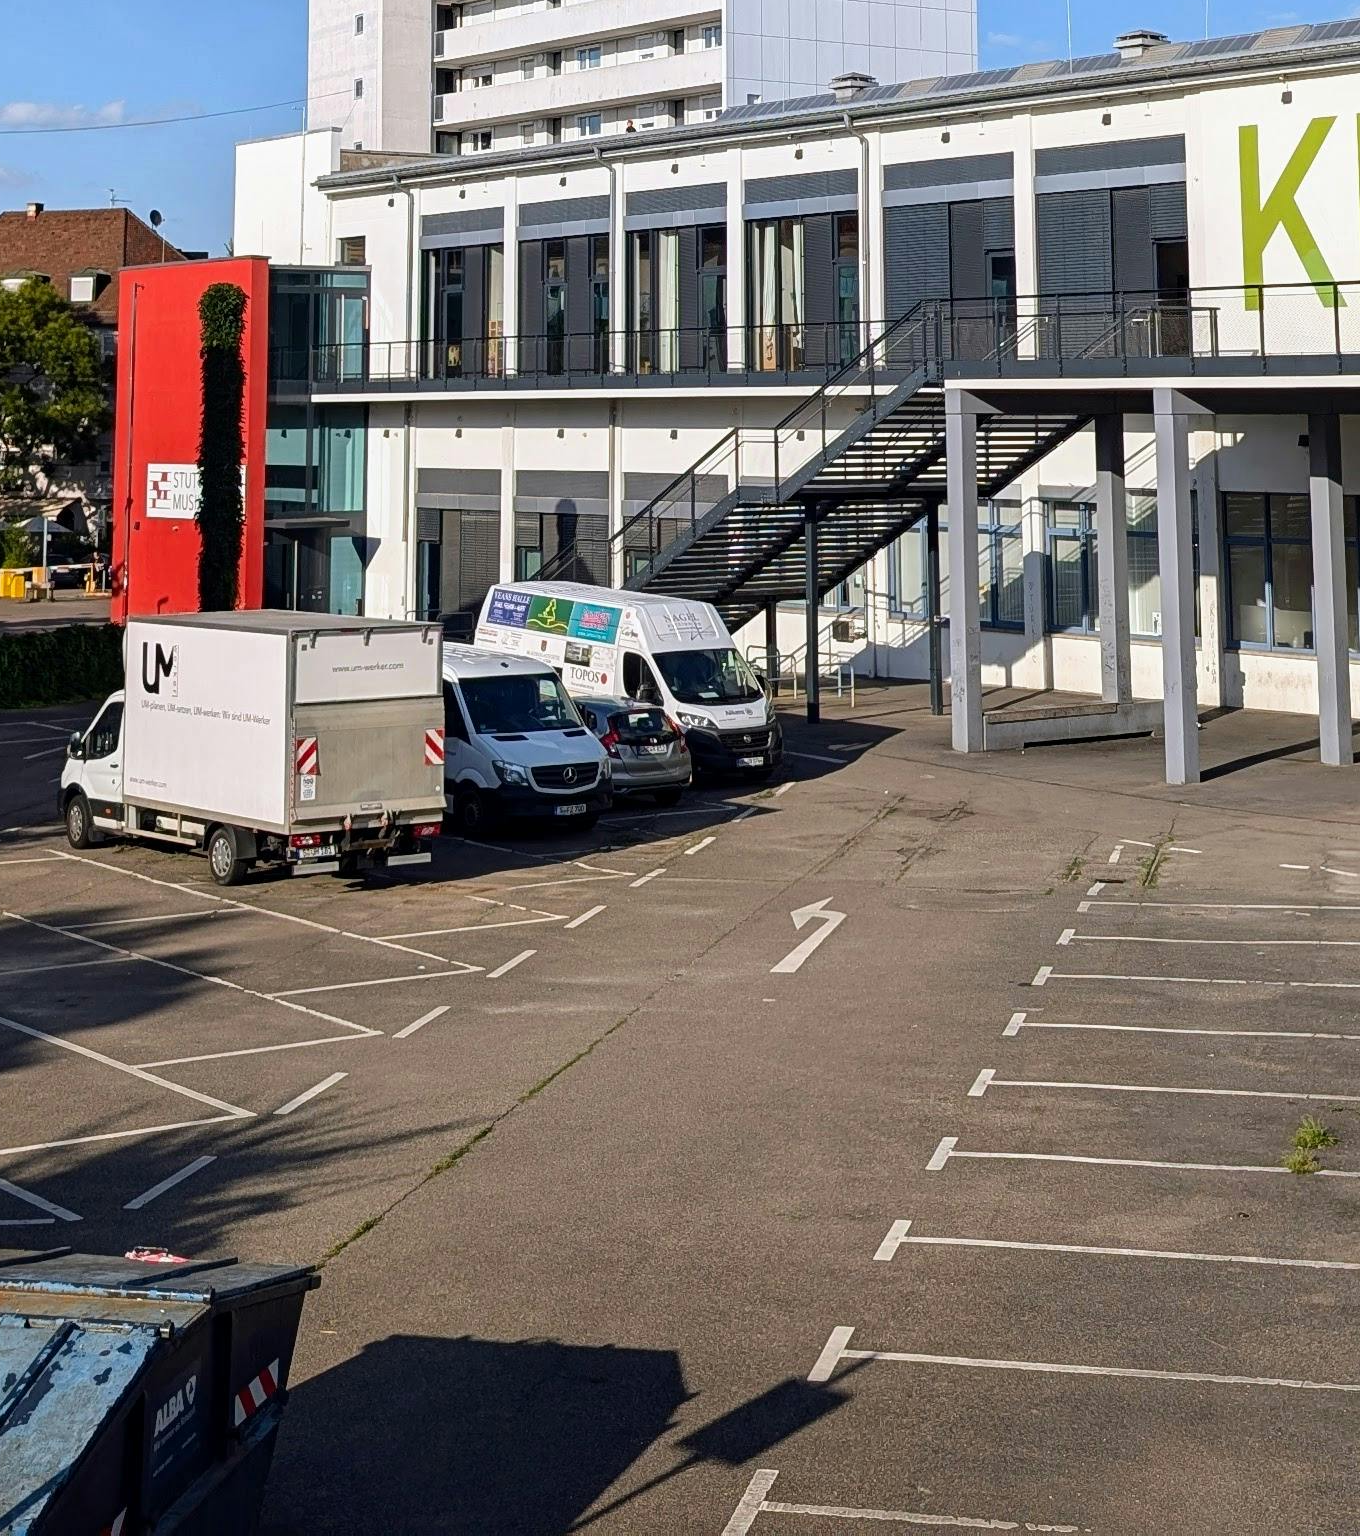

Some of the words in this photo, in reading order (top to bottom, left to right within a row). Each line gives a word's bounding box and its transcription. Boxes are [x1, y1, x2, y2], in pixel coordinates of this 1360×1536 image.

[512, 594, 531, 604] HALLE
[142, 642, 174, 695] UM
[332, 662, 404, 673] www.um-werker.com
[570, 667, 600, 683] TOPOS
[153, 1389, 185, 1438] ALBA
